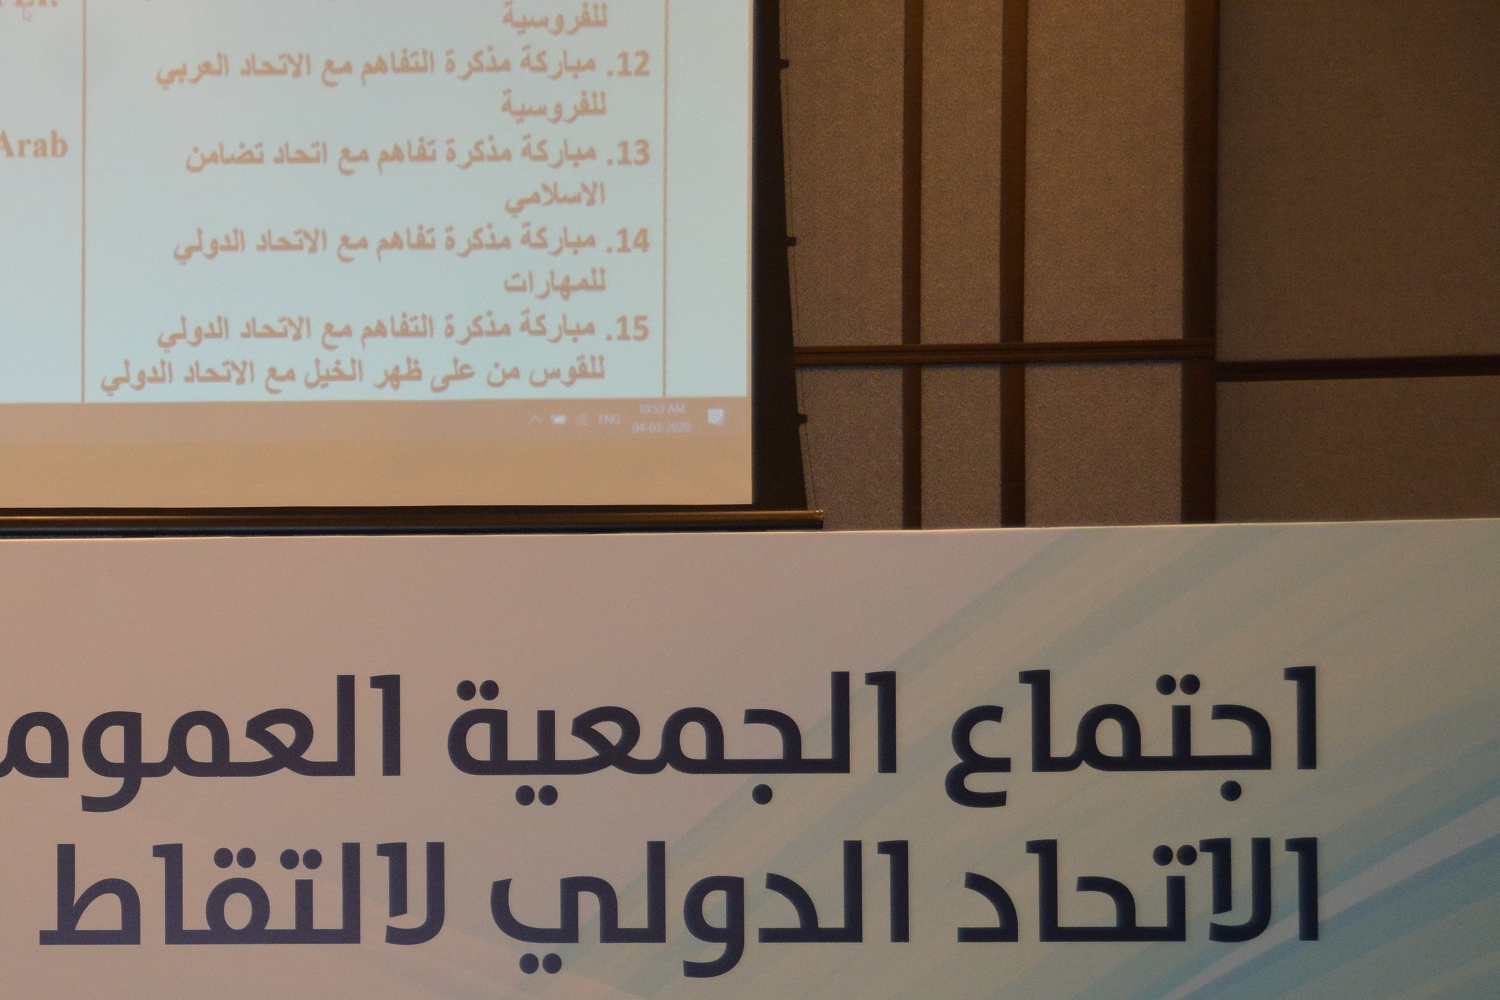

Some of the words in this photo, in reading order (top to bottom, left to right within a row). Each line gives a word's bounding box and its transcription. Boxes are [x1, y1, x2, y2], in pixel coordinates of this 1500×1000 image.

[154, 52, 229, 89] العربي
[239, 52, 311, 79] الاتحاد
[320, 58, 354, 88] مع
[360, 48, 435, 87] التفاهم
[444, 45, 513, 81] مذكرة
[519, 44, 597, 80] مباركة
[606, 49, 650, 78] 12.
[500, 89, 608, 124] للفروسية
[185, 142, 265, 174] تضامن
[272, 140, 327, 165] اتحاد
[338, 146, 370, 176] مع
[376, 136, 437, 177] تفاهم
[445, 134, 513, 171] مذكرة
[519, 133, 598, 170] مباركة
[605, 138, 651, 166] 13.
[503, 180, 607, 216] الاسلامي
[172, 227, 246, 264] الدولي
[255, 228, 328, 254] الاتحاد
[337, 233, 369, 264] مع
[376, 224, 437, 263] تفاهم
[443, 222, 513, 258] مذكرة
[519, 220, 597, 257] مباركة
[605, 226, 651, 254] 14.
[502, 266, 607, 301] للمهارات
[156, 315, 230, 352] الدولي
[239, 315, 312, 342] الاتحاد
[320, 321, 353, 351] مع
[360, 312, 435, 352] التفاهم
[443, 309, 512, 346] مذكرة
[519, 307, 597, 344] مباركة
[604, 313, 650, 342] 15.
[99, 358, 173, 395] الدولي
[183, 359, 255, 385] الاتحاد
[263, 366, 297, 395] مع
[303, 357, 363, 389] الخيل
[375, 356, 424, 391] ظهر
[429, 357, 475, 394] على
[486, 362, 522, 389] من
[528, 353, 606, 388] للقوس
[448, 671, 897, 806] الجمعية
[945, 666, 1317, 808] اجتماع
[39, 842, 445, 945] لالتقاط
[958, 837, 1321, 943] الاتحاد
[491, 840, 910, 978] الدولي
